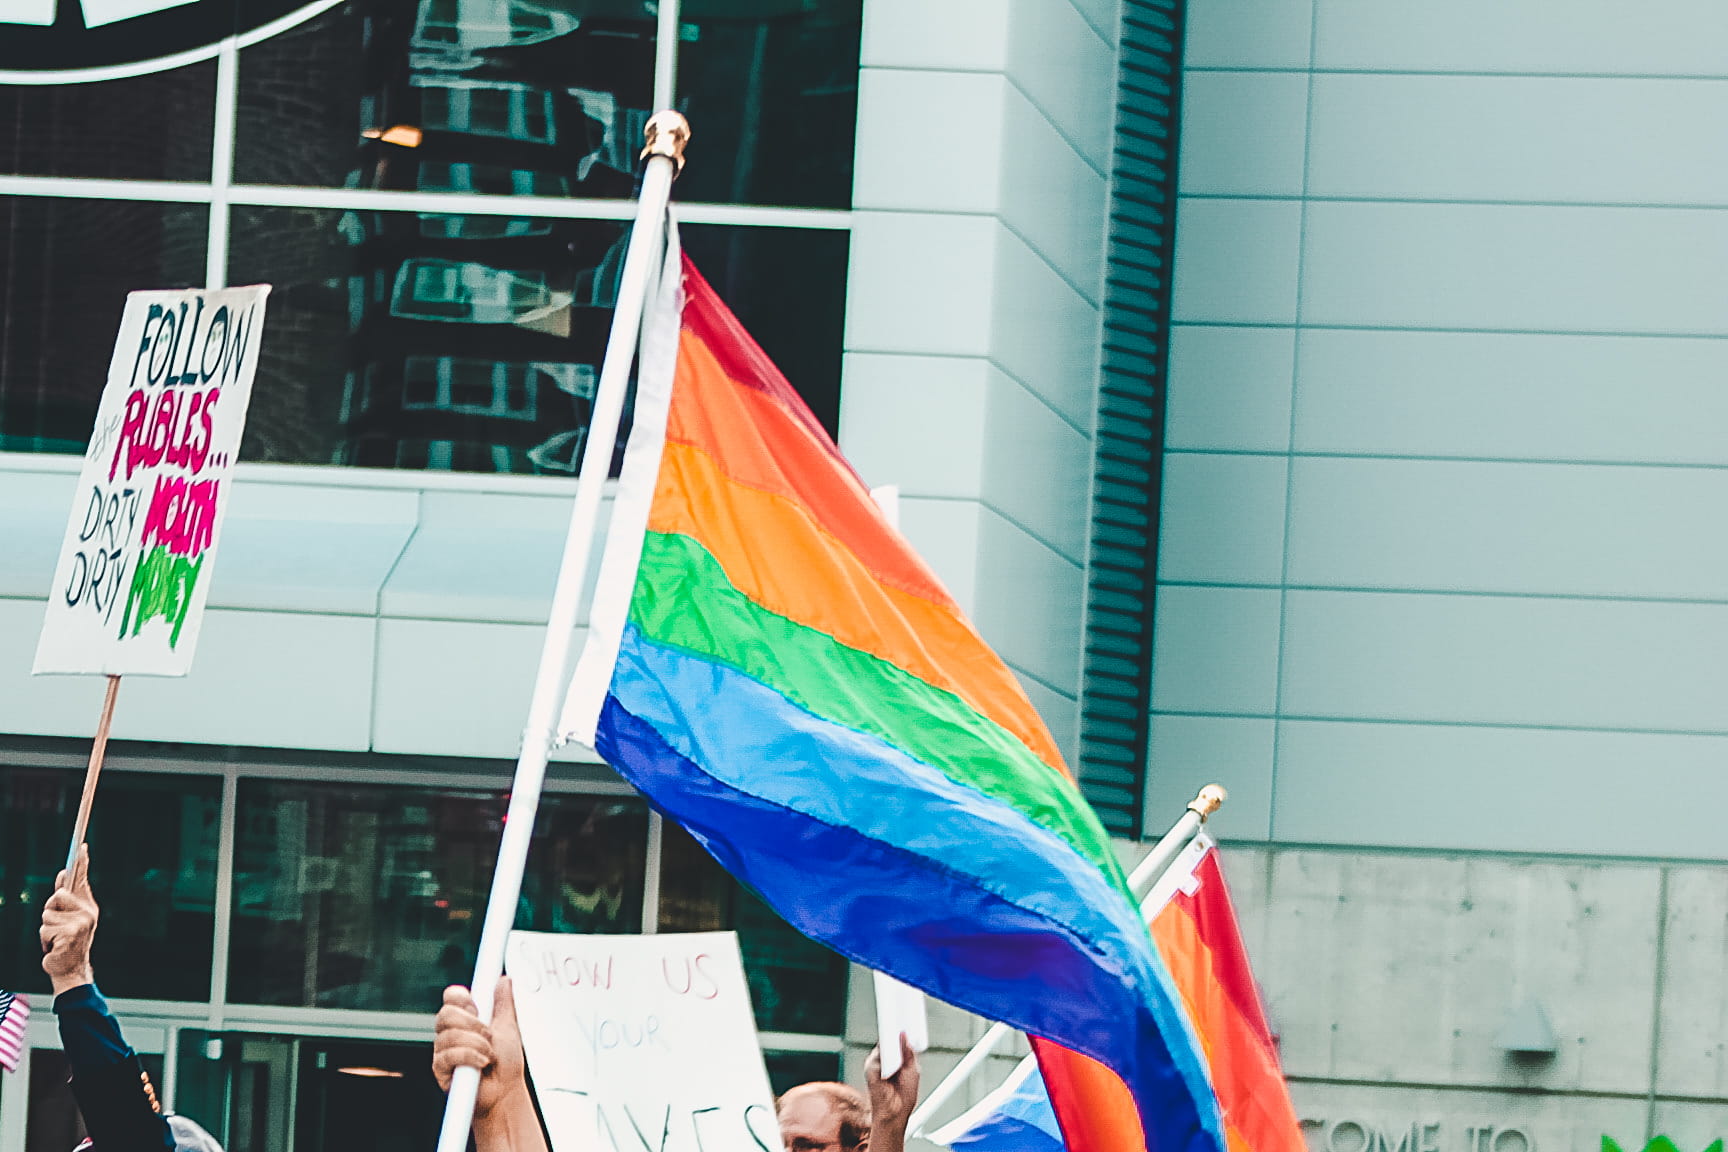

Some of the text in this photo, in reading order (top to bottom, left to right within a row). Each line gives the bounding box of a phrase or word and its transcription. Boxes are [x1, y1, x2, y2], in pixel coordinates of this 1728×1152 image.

[129, 295, 256, 389] FOLLOW
[79, 474, 220, 559] DIRTY MOUTH
[65, 544, 204, 653] DIRTY MONEY
[519, 939, 719, 1002] SHOW US
[573, 1010, 673, 1080] YOUR
